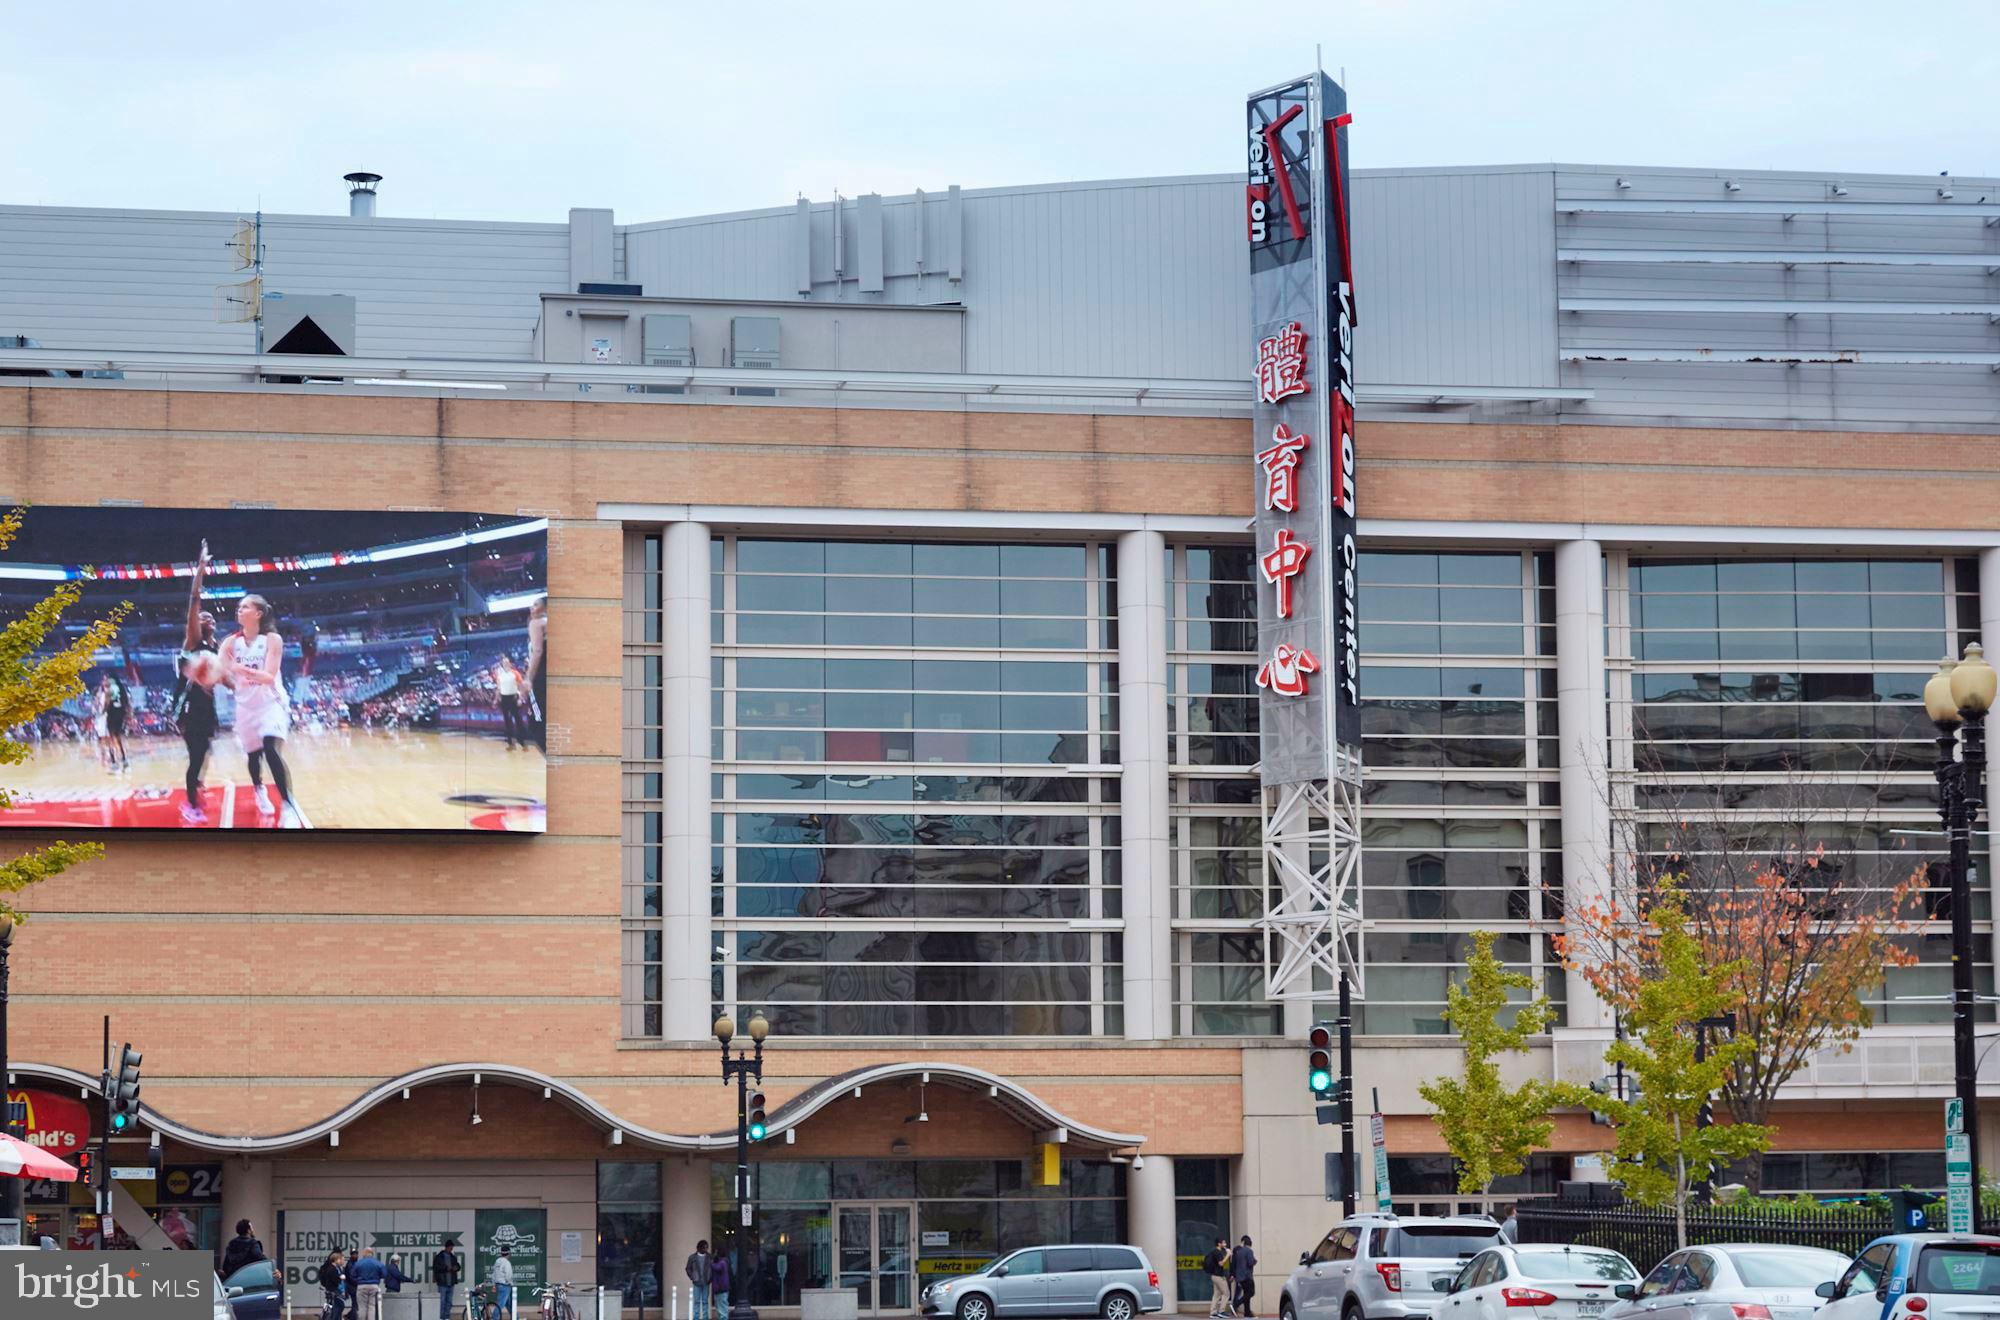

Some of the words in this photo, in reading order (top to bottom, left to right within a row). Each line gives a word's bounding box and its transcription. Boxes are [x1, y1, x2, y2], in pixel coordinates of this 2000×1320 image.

[1247, 123, 1271, 242] verizon
[1333, 281, 1356, 519] verizon
[1254, 321, 1321, 698] 體育中心
[1342, 531, 1358, 707] center
[26, 1129, 76, 1147] ald's
[286, 1231, 359, 1251] LEGENDS
[392, 1234, 442, 1245] THEY'RE
[932, 1260, 962, 1271] Hertz
[1953, 1262, 1981, 1273] 2264
[286, 1266, 321, 1285] BO
